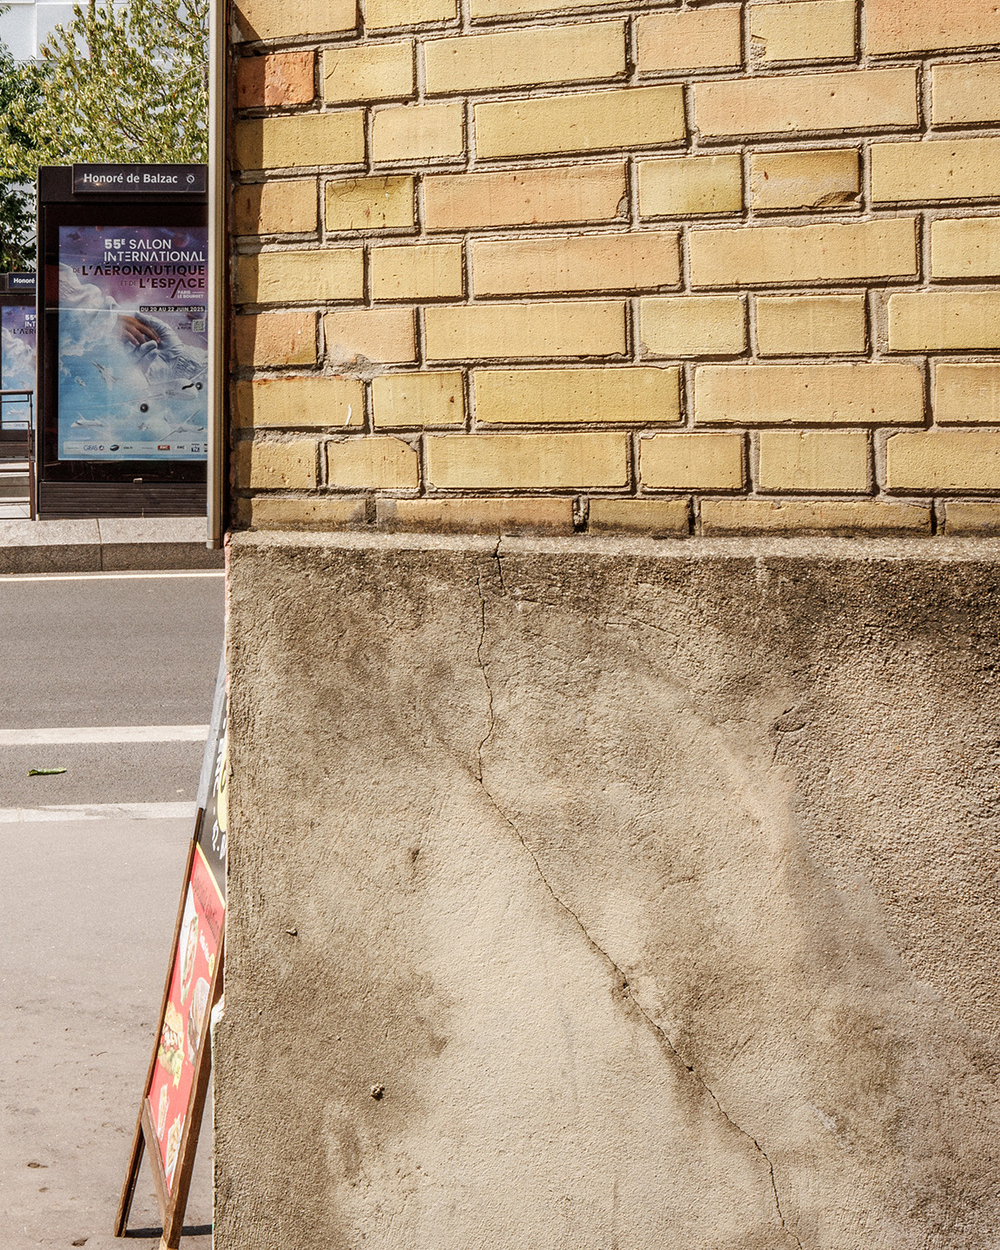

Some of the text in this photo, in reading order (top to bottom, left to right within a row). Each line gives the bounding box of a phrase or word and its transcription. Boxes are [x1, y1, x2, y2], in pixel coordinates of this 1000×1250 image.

[83, 172, 178, 183] Honoré de Balzac
[129, 238, 172, 250] SALON
[104, 250, 206, 262] INTERNATIONAL
[82, 262, 205, 275] L'AÉRONAUTIQUE
[139, 278, 205, 295] L'ESPACE
